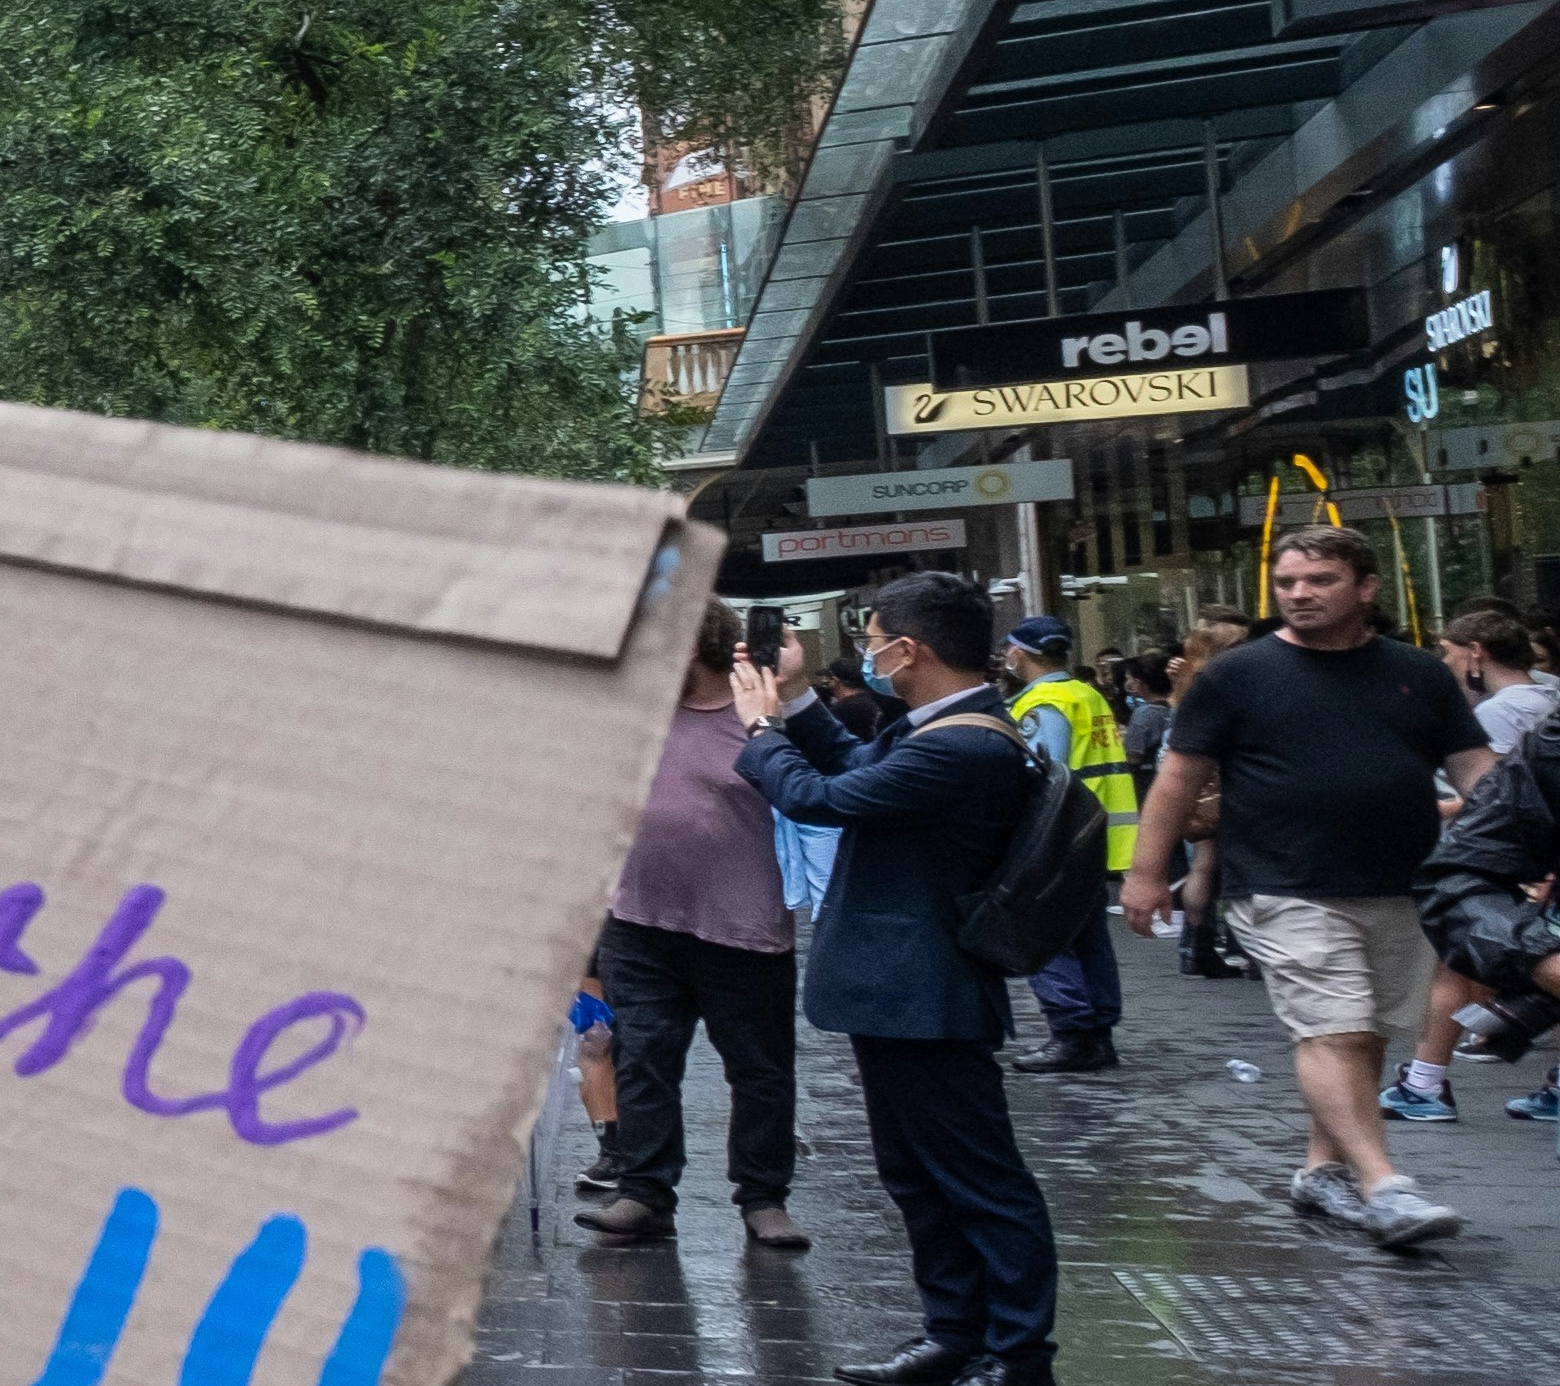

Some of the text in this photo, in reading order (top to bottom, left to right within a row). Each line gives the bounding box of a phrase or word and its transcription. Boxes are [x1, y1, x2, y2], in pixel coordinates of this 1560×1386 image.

[1061, 312, 1228, 368] rebel
[973, 370, 1217, 416] SWAROVSKI
[872, 479, 969, 499] SUNCORP
[777, 524, 952, 559] portmans
